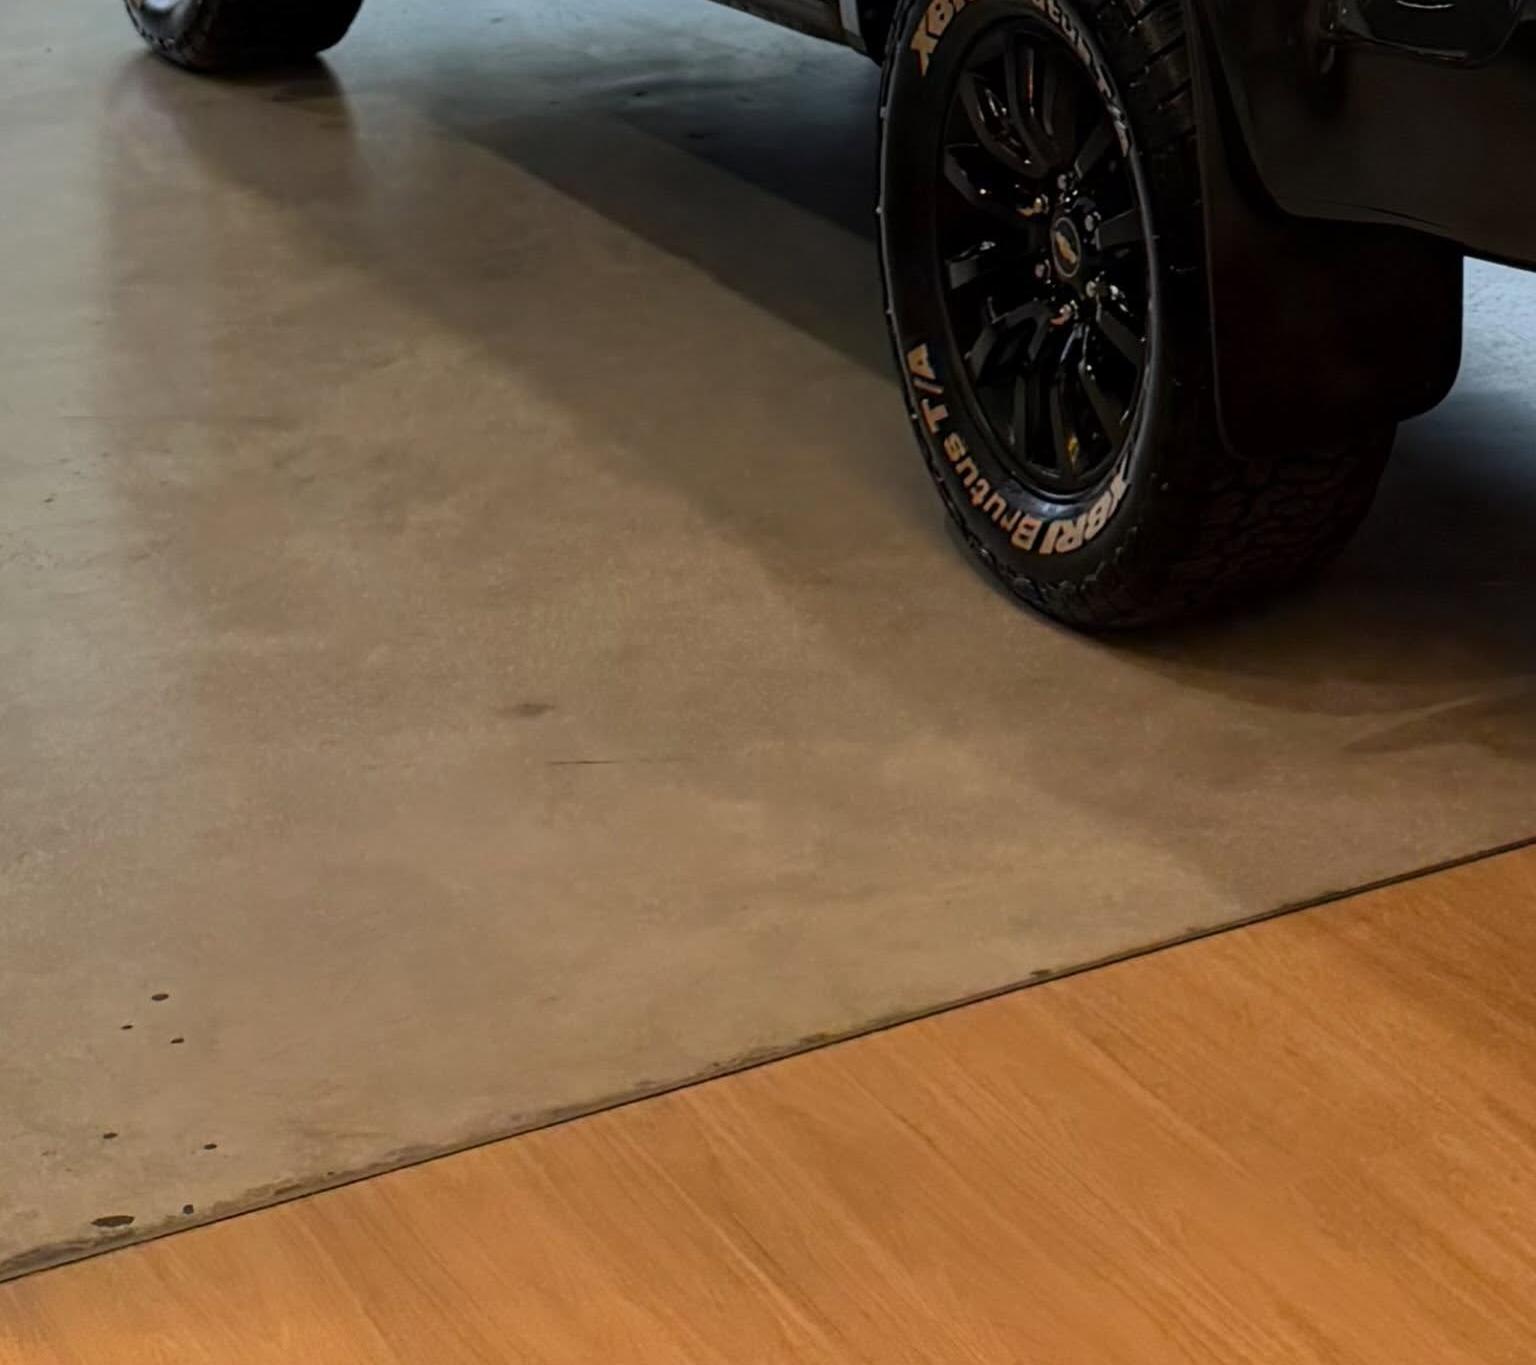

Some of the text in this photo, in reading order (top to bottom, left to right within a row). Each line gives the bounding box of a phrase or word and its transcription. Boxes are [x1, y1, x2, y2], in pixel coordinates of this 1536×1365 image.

[907, 343, 1129, 554] XBRI Brutus T/A
